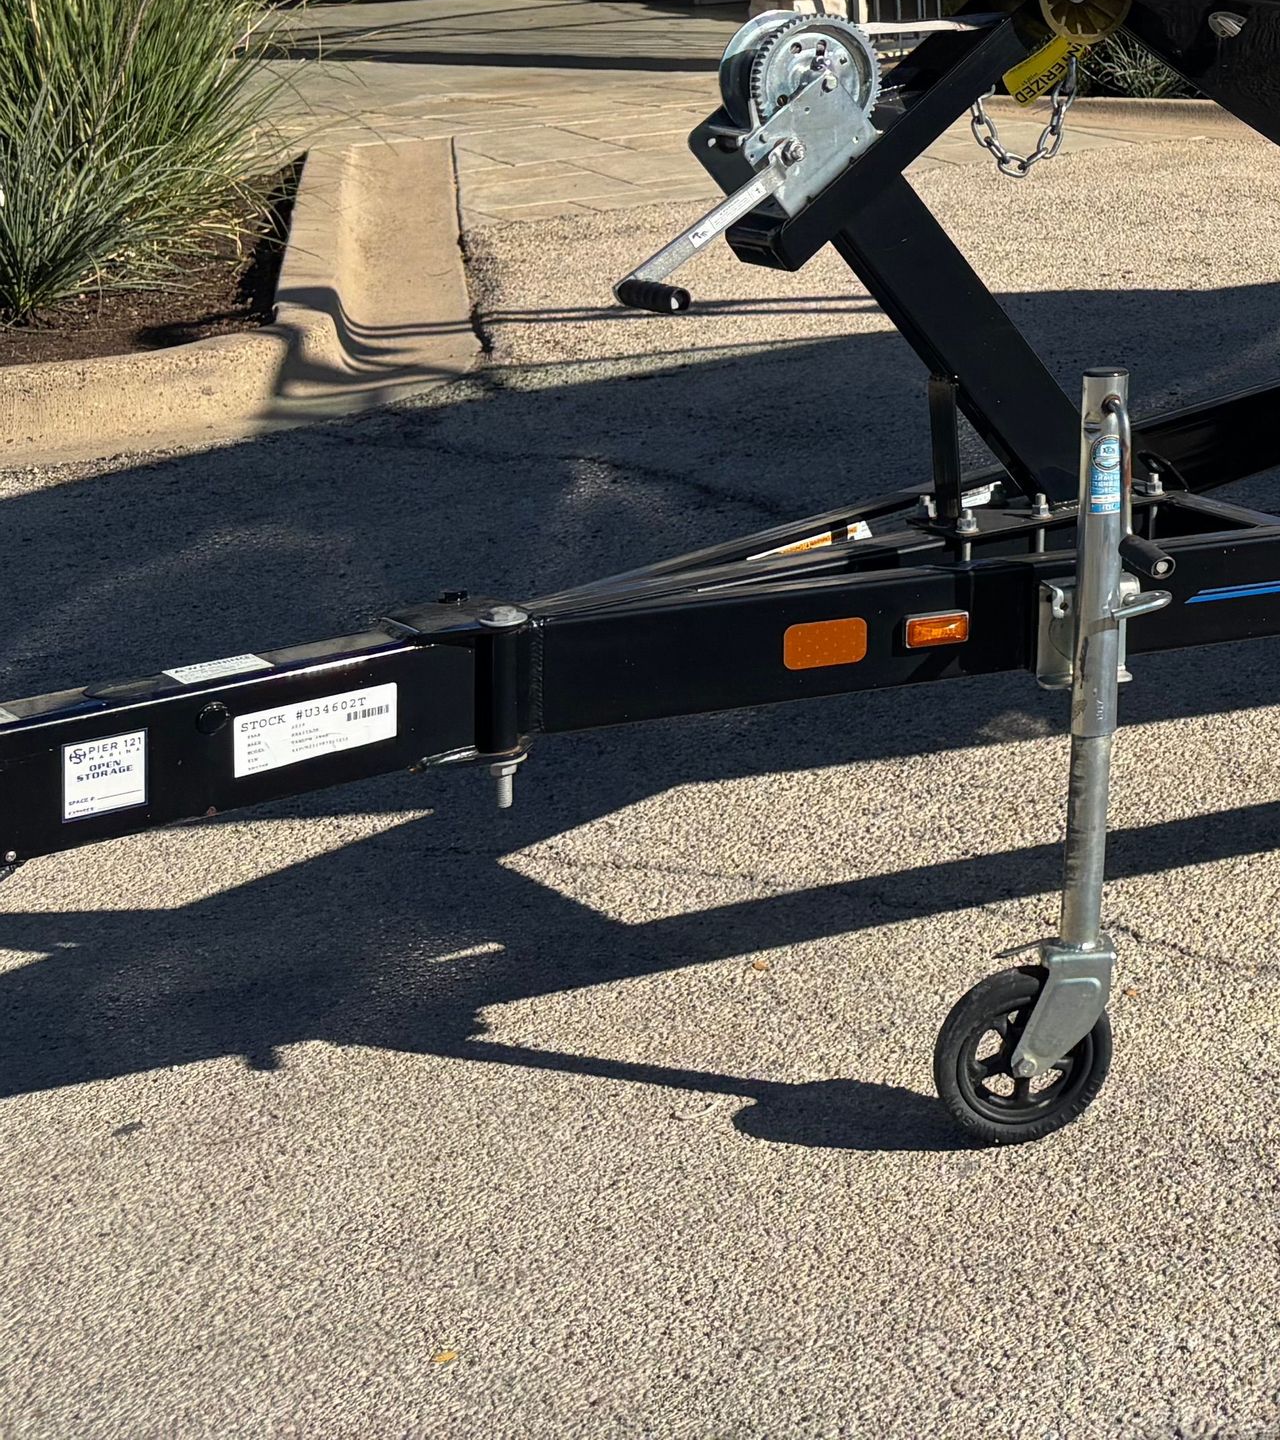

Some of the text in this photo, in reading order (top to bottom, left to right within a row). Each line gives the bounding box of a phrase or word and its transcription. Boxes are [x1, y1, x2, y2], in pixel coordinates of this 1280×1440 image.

[240, 714, 287, 733] STOCK
[295, 697, 367, 721] #U34602T
[88, 736, 142, 755] PIER 121
[76, 764, 134, 783] STORAGE
[88, 759, 122, 772] OPEN
